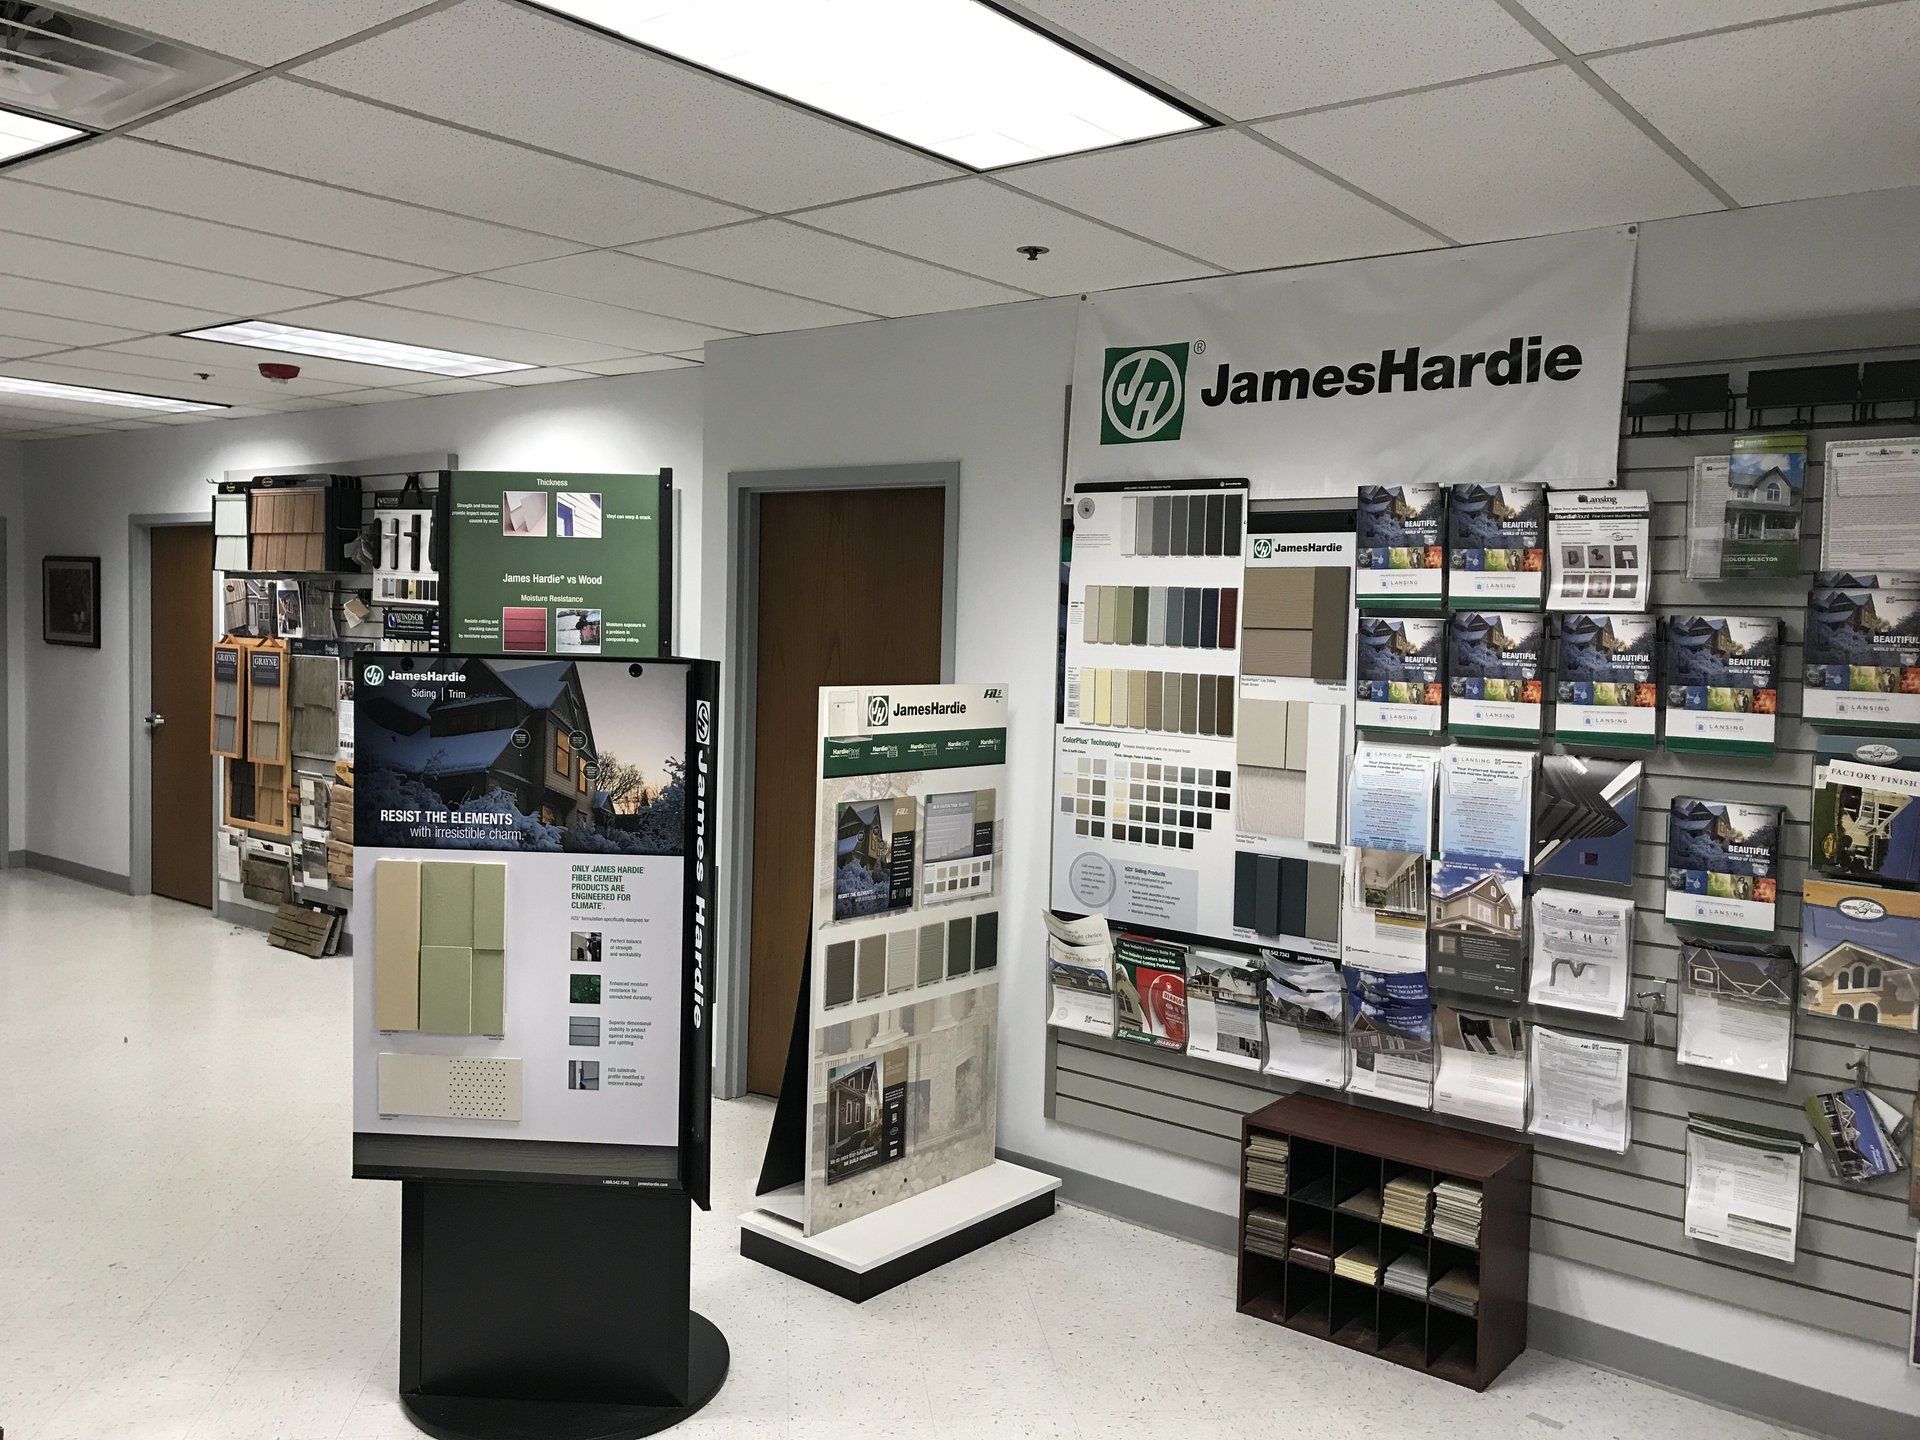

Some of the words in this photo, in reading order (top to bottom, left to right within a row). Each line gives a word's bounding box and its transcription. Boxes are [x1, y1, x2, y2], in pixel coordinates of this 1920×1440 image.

[1200, 336, 1583, 407] JamesHardie
[536, 478, 568, 487] Thickness
[1586, 495, 1618, 504] Lansing
[1405, 520, 1437, 528] BEAUTIFUL
[1274, 543, 1342, 554] JamesHardie
[502, 574, 530, 584] James
[579, 575, 602, 585] Wood
[521, 594, 548, 602] Moisture
[549, 595, 583, 603] Resistance
[395, 613, 423, 622] WINDSOR
[1874, 635, 1920, 644] BEAUTIFUL
[1405, 656, 1437, 664] BEAUTIFUL
[1502, 652, 1537, 660] BEAUTIFUL
[1612, 654, 1650, 662] BEAUTIFUL
[254, 658, 278, 666] GRAYNE
[1728, 658, 1770, 666] BEAUTIFUL
[388, 670, 466, 682] JamesHardie
[411, 688, 436, 700] Siding
[448, 690, 466, 699] Trim
[893, 702, 966, 716] JamesHardie
[1090, 738, 1121, 748] Technology
[1831, 768, 1877, 781] FACTORY
[1881, 776, 1917, 787] FINISH
[380, 810, 421, 822] RESIST
[425, 811, 447, 823] THE
[451, 812, 513, 825] ELEMENTS
[696, 750, 707, 882] James
[410, 827, 431, 838] with
[435, 827, 485, 839] irresistible
[489, 828, 524, 841] charm.
[1728, 845, 1770, 856] BEAUTIFUL
[591, 865, 616, 873] JAMES
[572, 874, 592, 882] FIBER
[610, 884, 625, 892] ARE
[572, 892, 615, 901] ENGINEERED
[1709, 910, 1744, 918] LANSING
[1130, 951, 1142, 959] Industry
[694, 895, 705, 1029] Hardie
